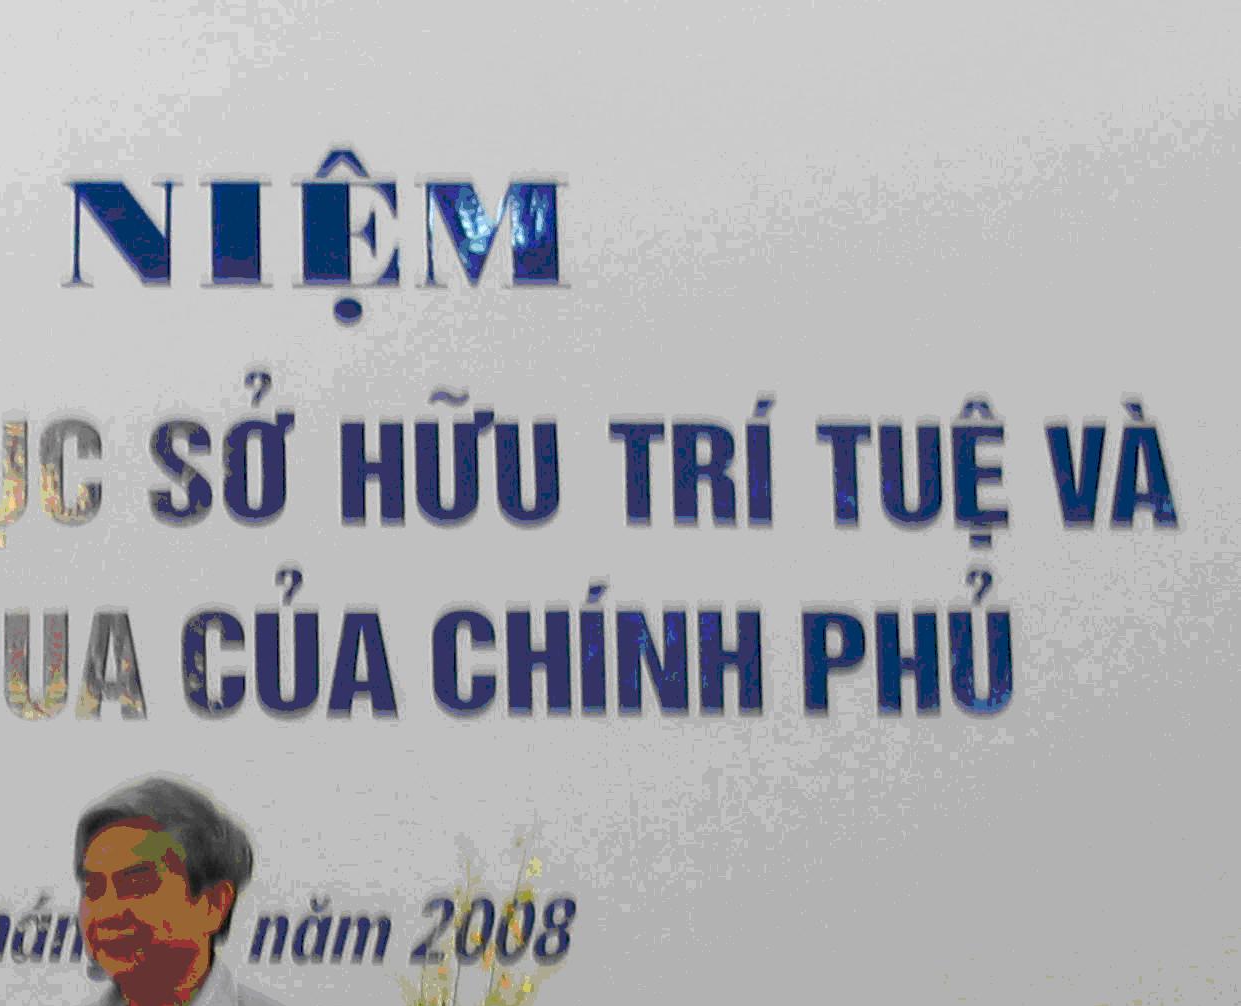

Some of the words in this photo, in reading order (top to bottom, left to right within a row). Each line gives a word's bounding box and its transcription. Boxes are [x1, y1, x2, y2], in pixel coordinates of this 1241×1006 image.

[60, 147, 572, 326] NIỆM
[149, 372, 295, 526] SỞ
[340, 390, 561, 527] HỮU
[609, 395, 776, 528] TRÍ
[816, 399, 1010, 549] TUỆ
[1044, 400, 1179, 528] VÀ
[182, 567, 399, 719] CỦA
[432, 583, 764, 716] CHÍNH
[802, 570, 1014, 716] PHỦ
[249, 899, 393, 965] năm
[410, 896, 577, 965] 2008
